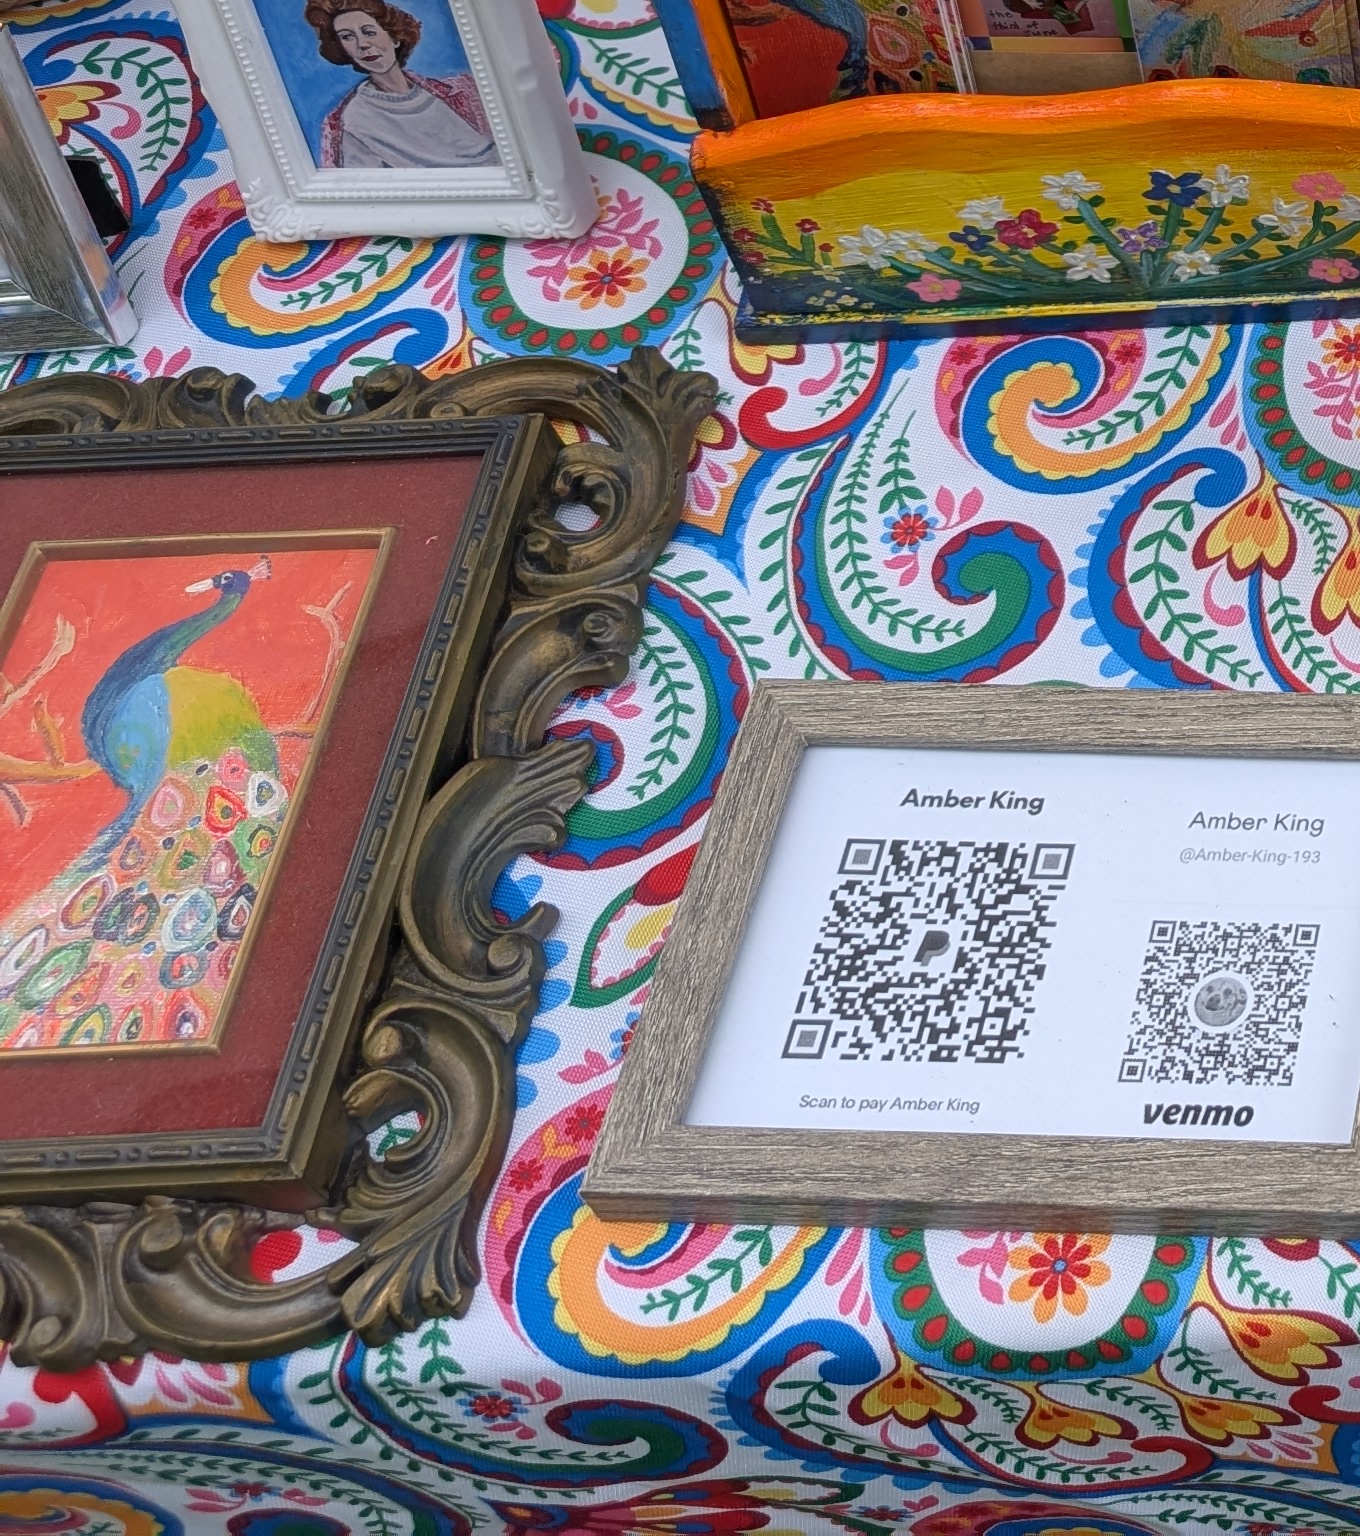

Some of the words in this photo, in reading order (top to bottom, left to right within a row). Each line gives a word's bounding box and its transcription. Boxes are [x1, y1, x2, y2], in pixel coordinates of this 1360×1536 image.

[900, 787, 987, 810] Amber
[988, 789, 1046, 816] King
[1187, 810, 1268, 831] Amber
[1273, 812, 1325, 838] King
[1179, 847, 1321, 866] @Amber-King-193
[799, 1094, 837, 1109] Scan
[841, 1095, 856, 1109] to
[858, 1097, 888, 1113] pay
[889, 1096, 944, 1112] Amber
[946, 1097, 981, 1115] King
[1143, 1102, 1255, 1127] venmo
